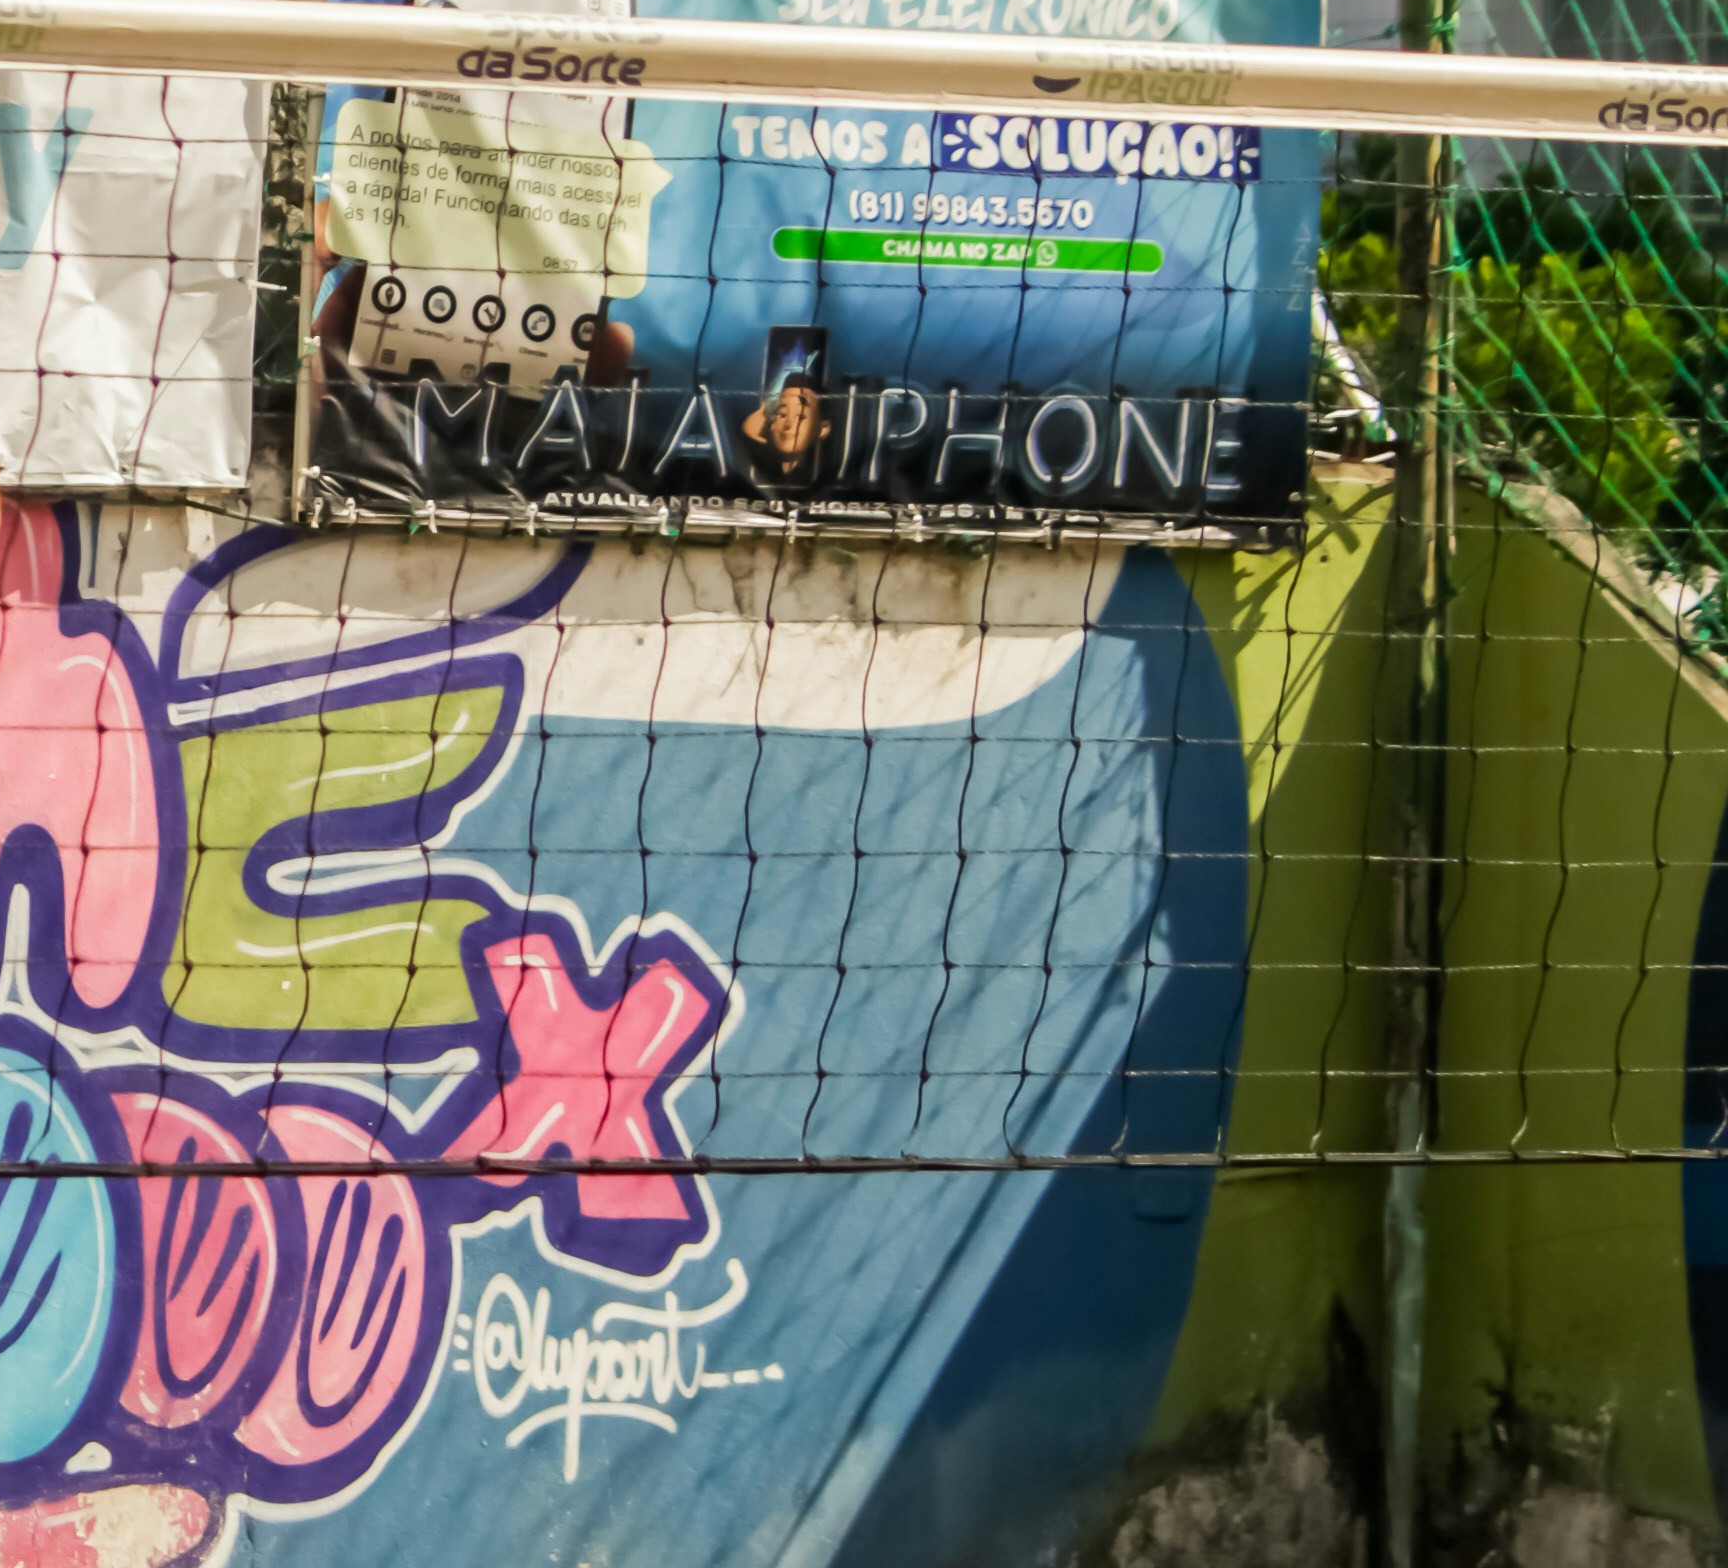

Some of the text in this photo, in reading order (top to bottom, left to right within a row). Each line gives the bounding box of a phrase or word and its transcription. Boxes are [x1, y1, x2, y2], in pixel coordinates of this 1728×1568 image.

[351, 124, 364, 142] A
[438, 140, 482, 159] para
[731, 115, 888, 164] TEMOS
[900, 123, 931, 166] A
[349, 152, 642, 209] clientes de forma mais acessvel
[363, 179, 428, 203] rápda!
[558, 208, 591, 228] das
[849, 189, 1095, 231] (81) 99843.5670
[542, 255, 579, 272] 08:57
[882, 239, 1033, 262] CHAMA NO ZAP
[414, 376, 1246, 492] MAIA IPHONE
[543, 491, 724, 511] ATUALIZANDO
